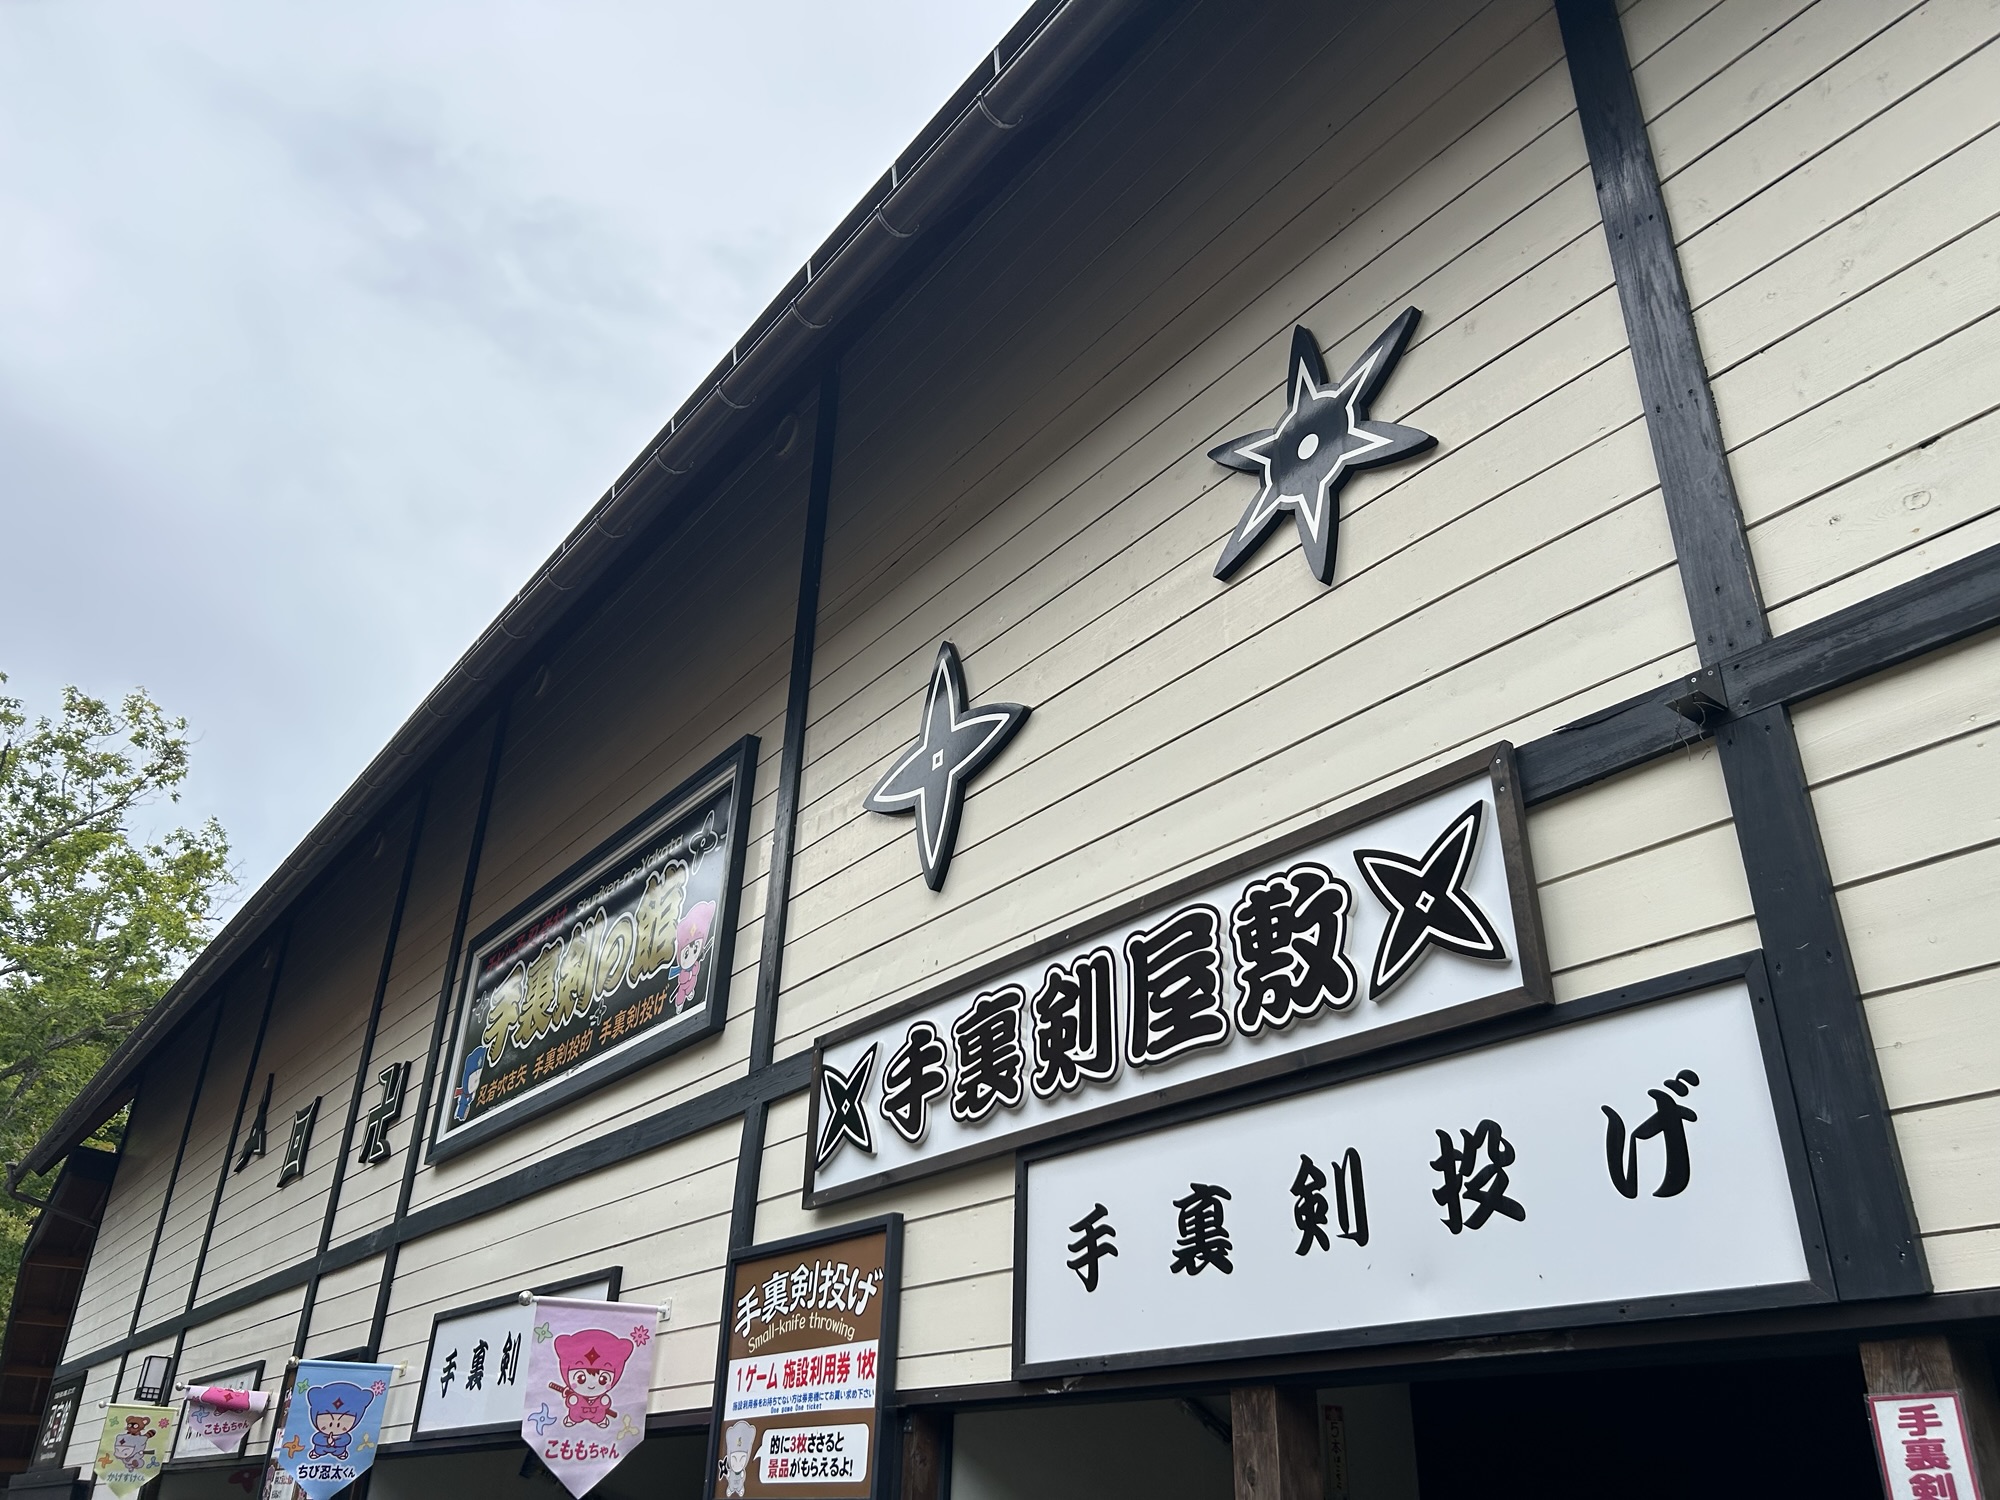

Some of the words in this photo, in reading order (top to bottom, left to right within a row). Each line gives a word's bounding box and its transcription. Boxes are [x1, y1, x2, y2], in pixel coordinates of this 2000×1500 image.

[575, 834, 684, 916] Shuriken-no-Yakata
[483, 859, 689, 1067] 手裏剣の館
[879, 861, 1358, 1145] 手裏剣屋敷
[475, 1063, 528, 1108] 忍者吹き矢
[532, 1028, 594, 1080] 手裏剣投的
[598, 983, 670, 1045] 手裏剣投げ
[1066, 1068, 1700, 1293] 手裏剣投げ
[734, 1260, 884, 1338] 手裏剣投げ
[748, 1312, 806, 1354] Small-knife
[809, 1312, 856, 1341] throwing
[782, 1351, 851, 1389] 施設利用券
[856, 1348, 876, 1380] 1枚
[204, 1421, 249, 1435] こももちゃん
[770, 1406, 780, 1414] One
[298, 1464, 356, 1480] ちび忍太くん
[544, 1439, 620, 1461] こももちゃん
[770, 1430, 844, 1455] 的に3枚ささると
[1898, 1404, 1959, 1500] 手裏剣
